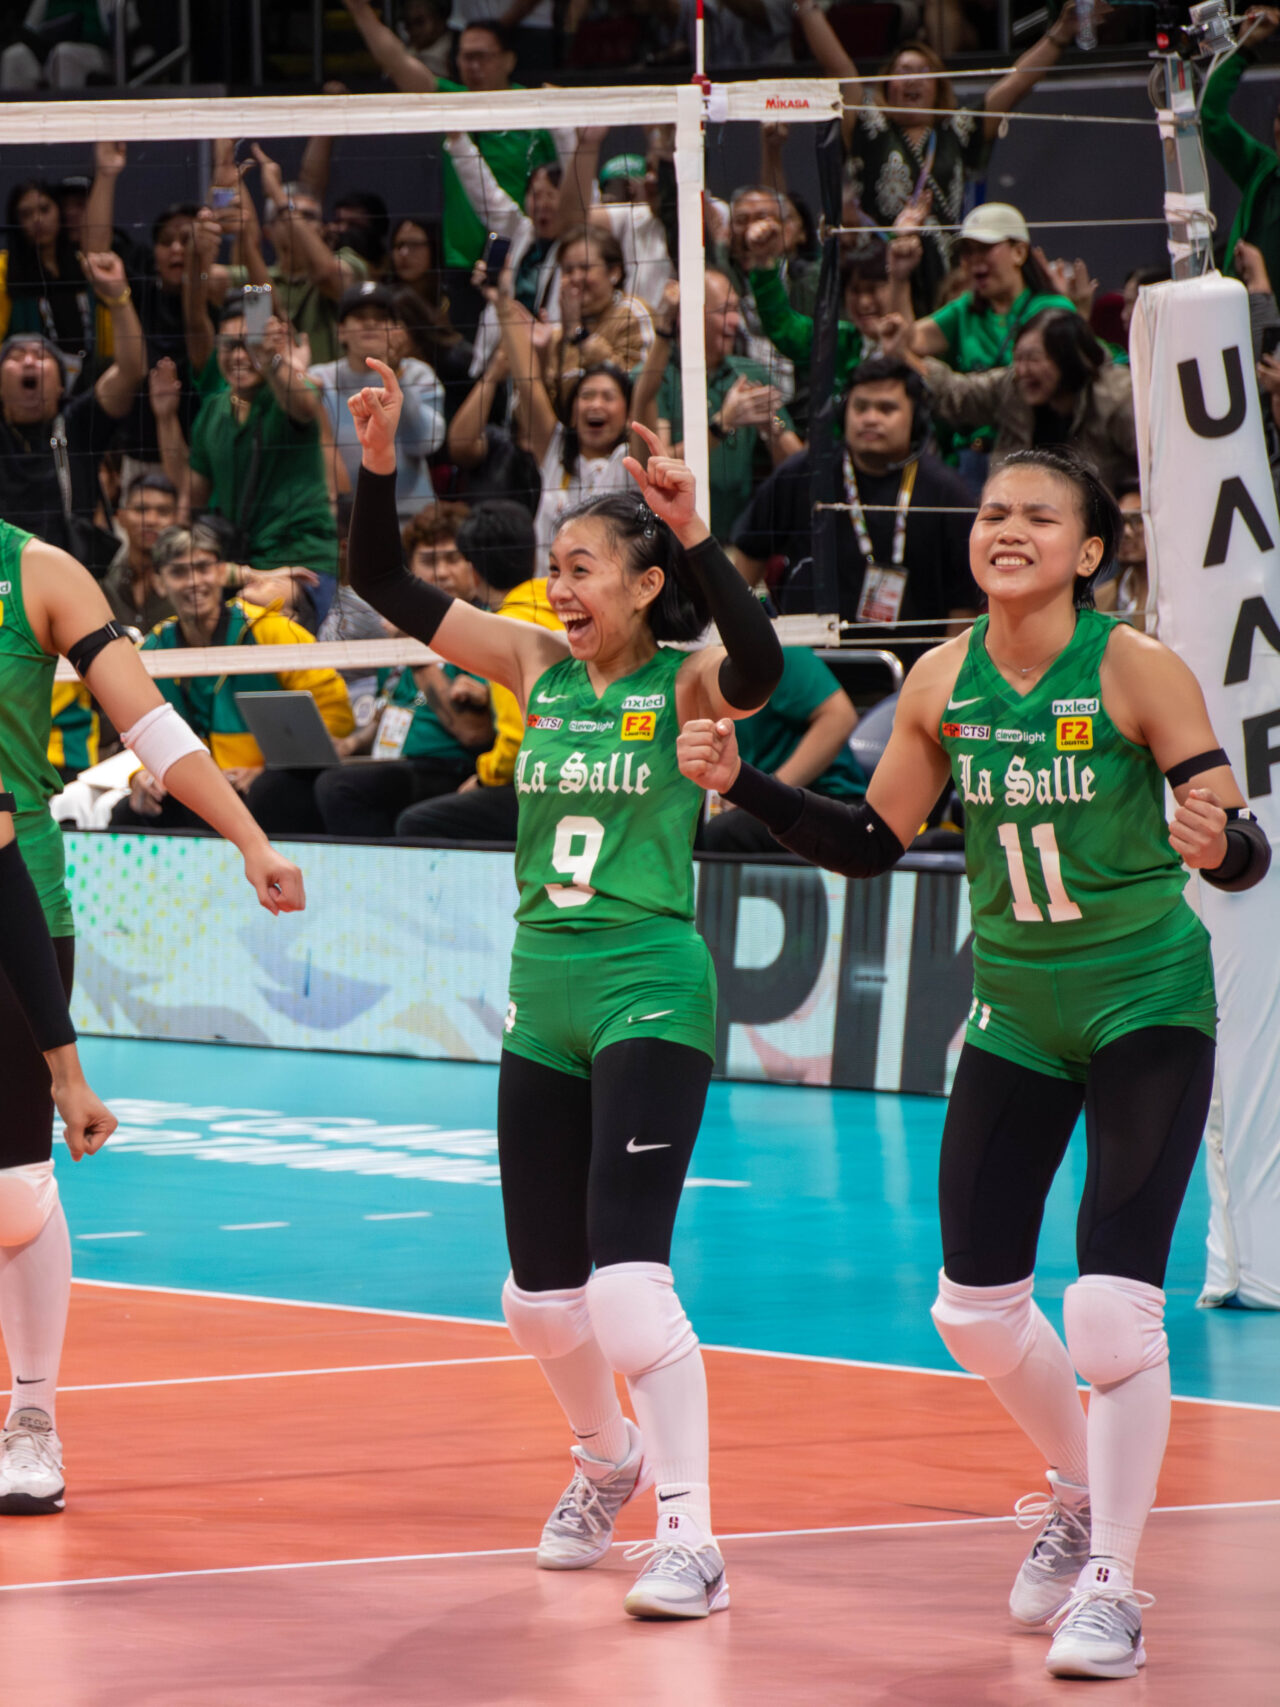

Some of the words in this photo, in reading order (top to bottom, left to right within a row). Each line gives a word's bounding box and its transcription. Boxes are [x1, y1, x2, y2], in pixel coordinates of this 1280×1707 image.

[765, 95, 809, 109] MIKASA
[623, 696, 663, 708] nxled
[1054, 700, 1097, 713] nxled
[625, 716, 651, 731] F2
[1061, 721, 1088, 740] F2
[960, 725, 989, 738] ICTSI
[1023, 731, 1046, 744] light
[516, 750, 547, 794] La
[559, 752, 651, 795] Salle
[958, 753, 994, 805] La
[1004, 755, 1096, 807] Salle
[544, 815, 605, 908] 9
[997, 823, 1083, 922] 11
